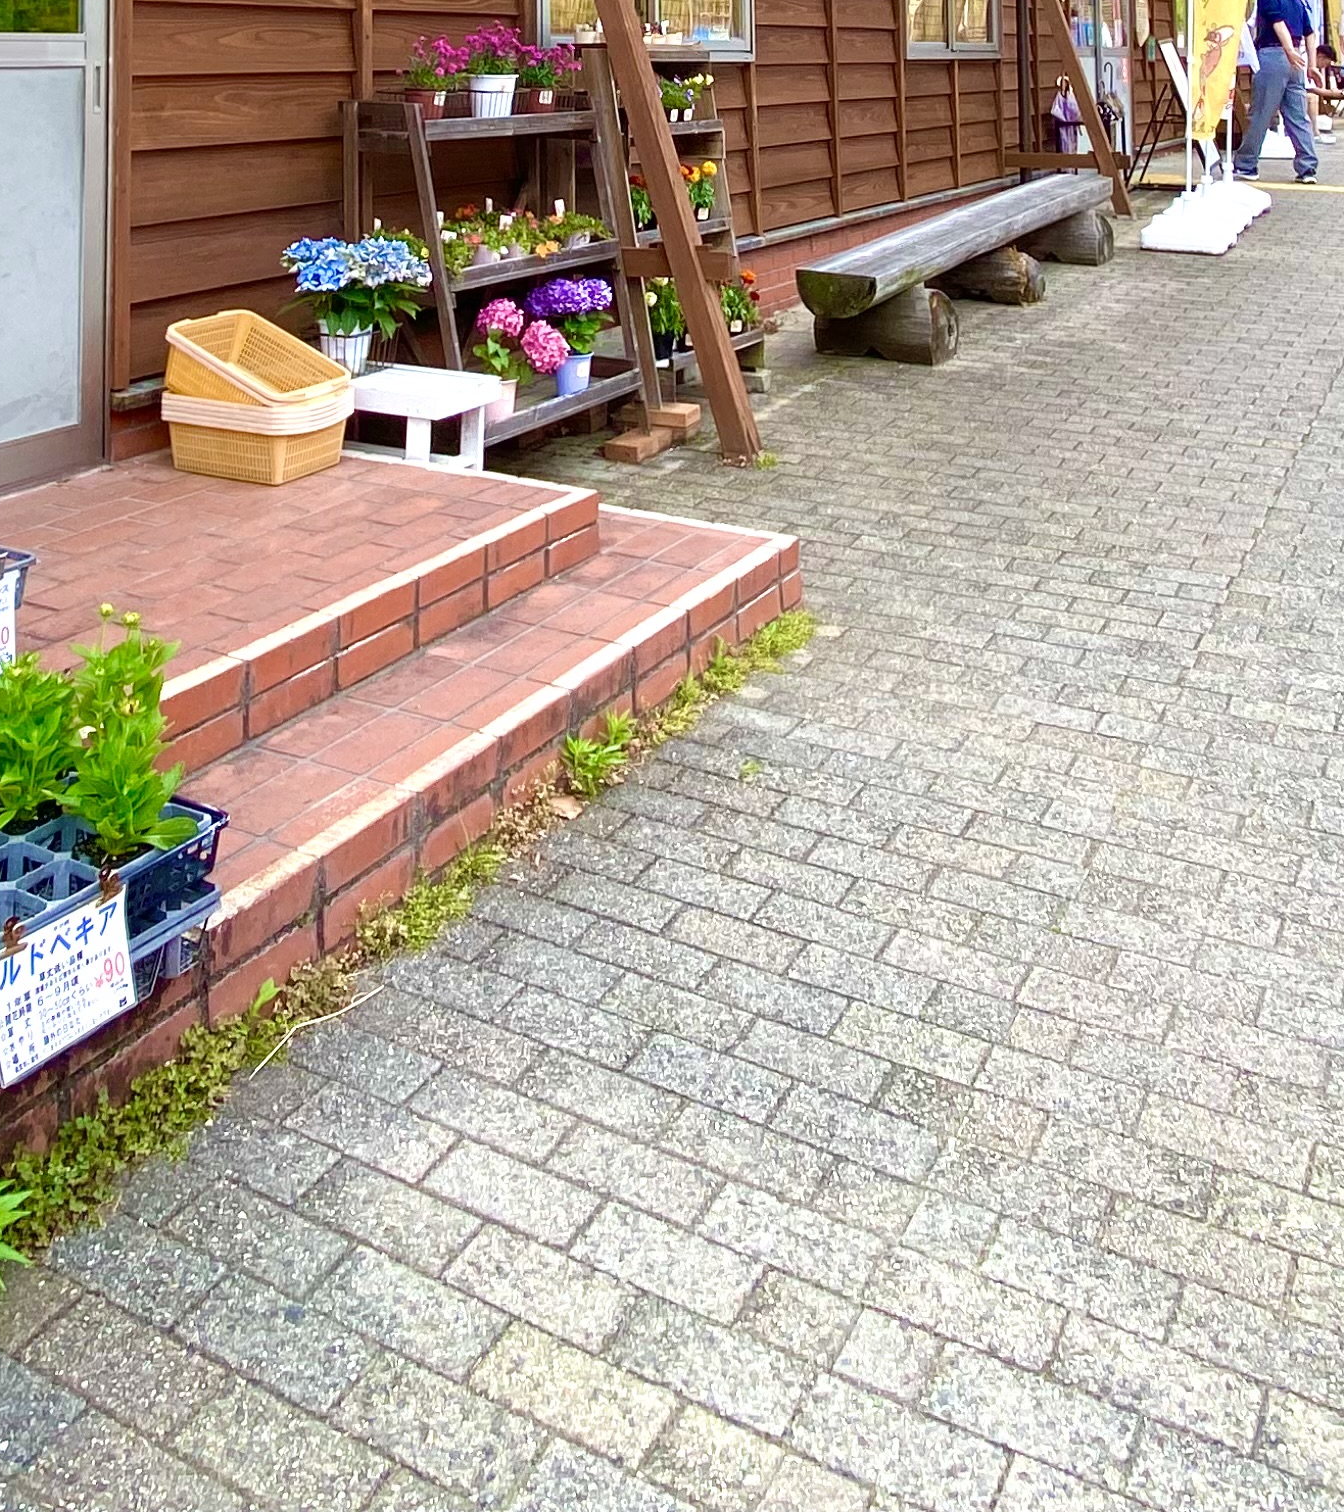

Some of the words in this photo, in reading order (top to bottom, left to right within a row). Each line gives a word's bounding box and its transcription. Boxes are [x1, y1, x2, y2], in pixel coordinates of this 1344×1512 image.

[0, 901, 118, 991] ルドベキア
[94, 951, 124, 987] ¥90
